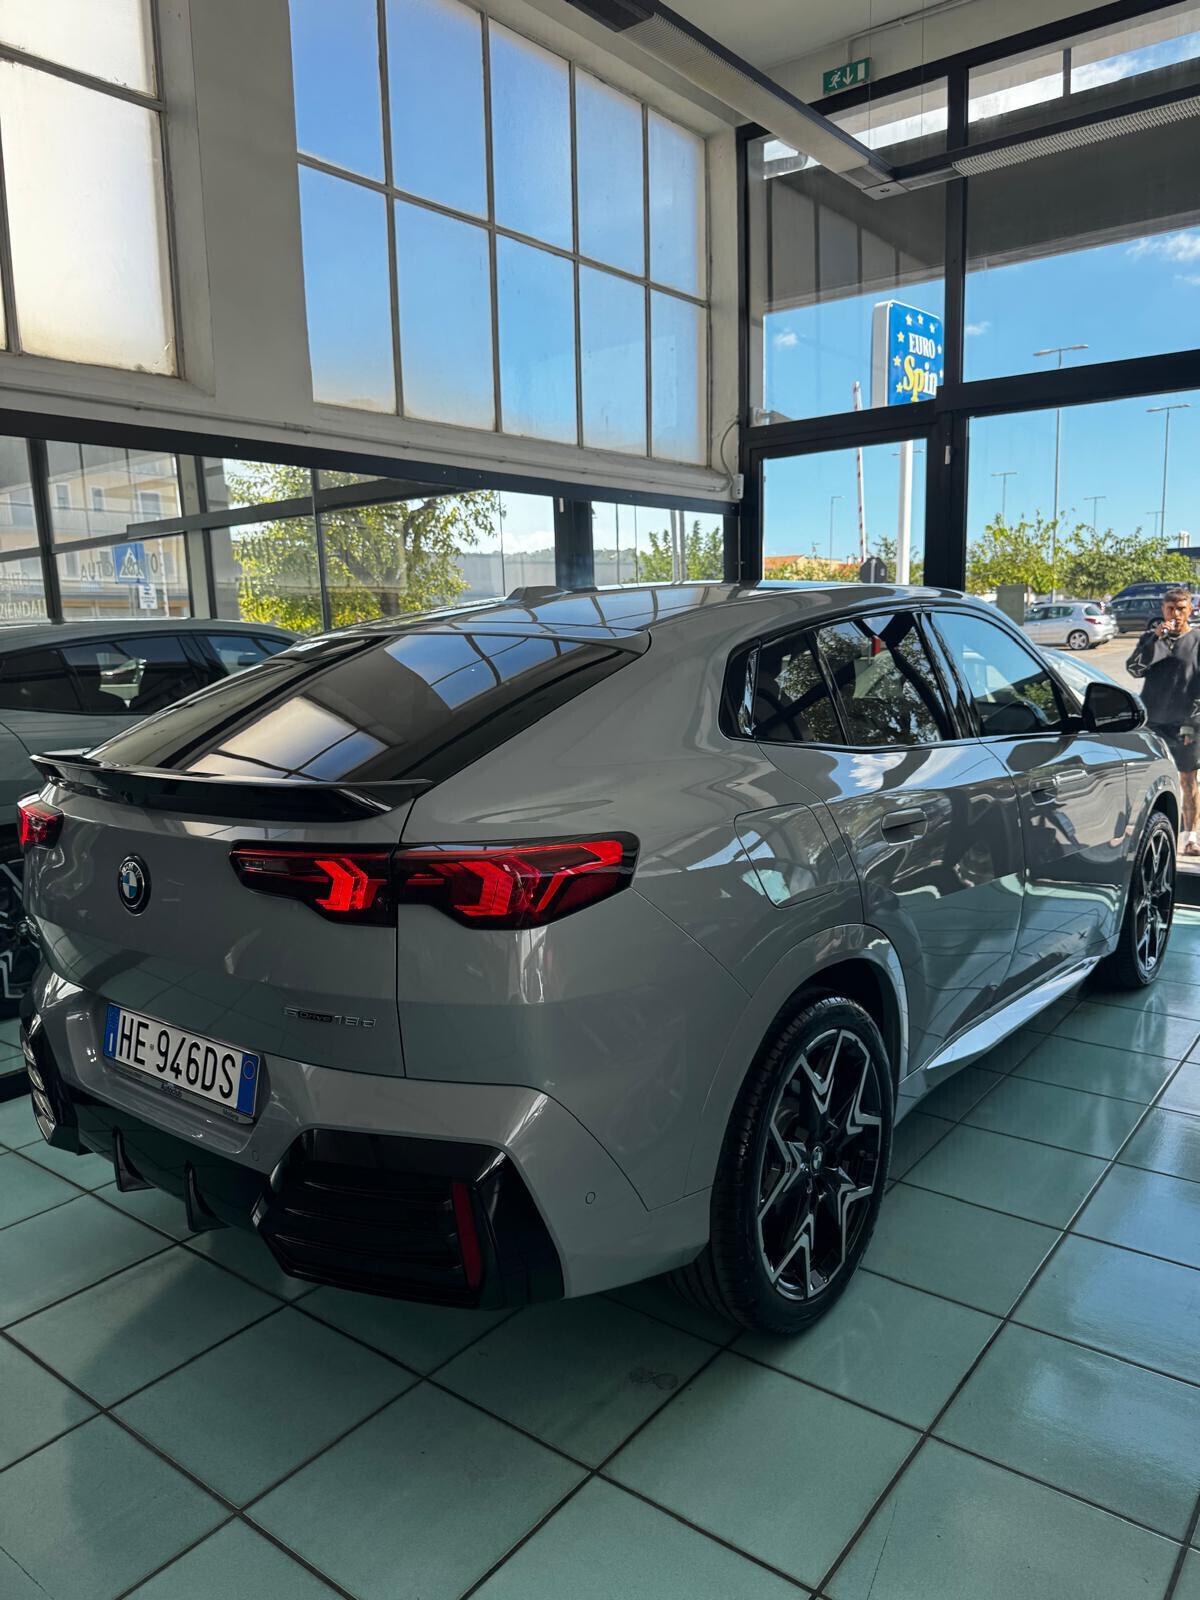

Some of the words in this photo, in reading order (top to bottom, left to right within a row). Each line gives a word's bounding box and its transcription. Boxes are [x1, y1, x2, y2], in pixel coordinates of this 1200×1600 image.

[909, 332, 936, 359] EURO
[903, 355, 938, 402] Spin
[119, 1015, 149, 1066] HE
[156, 1029, 236, 1099] 946DS
